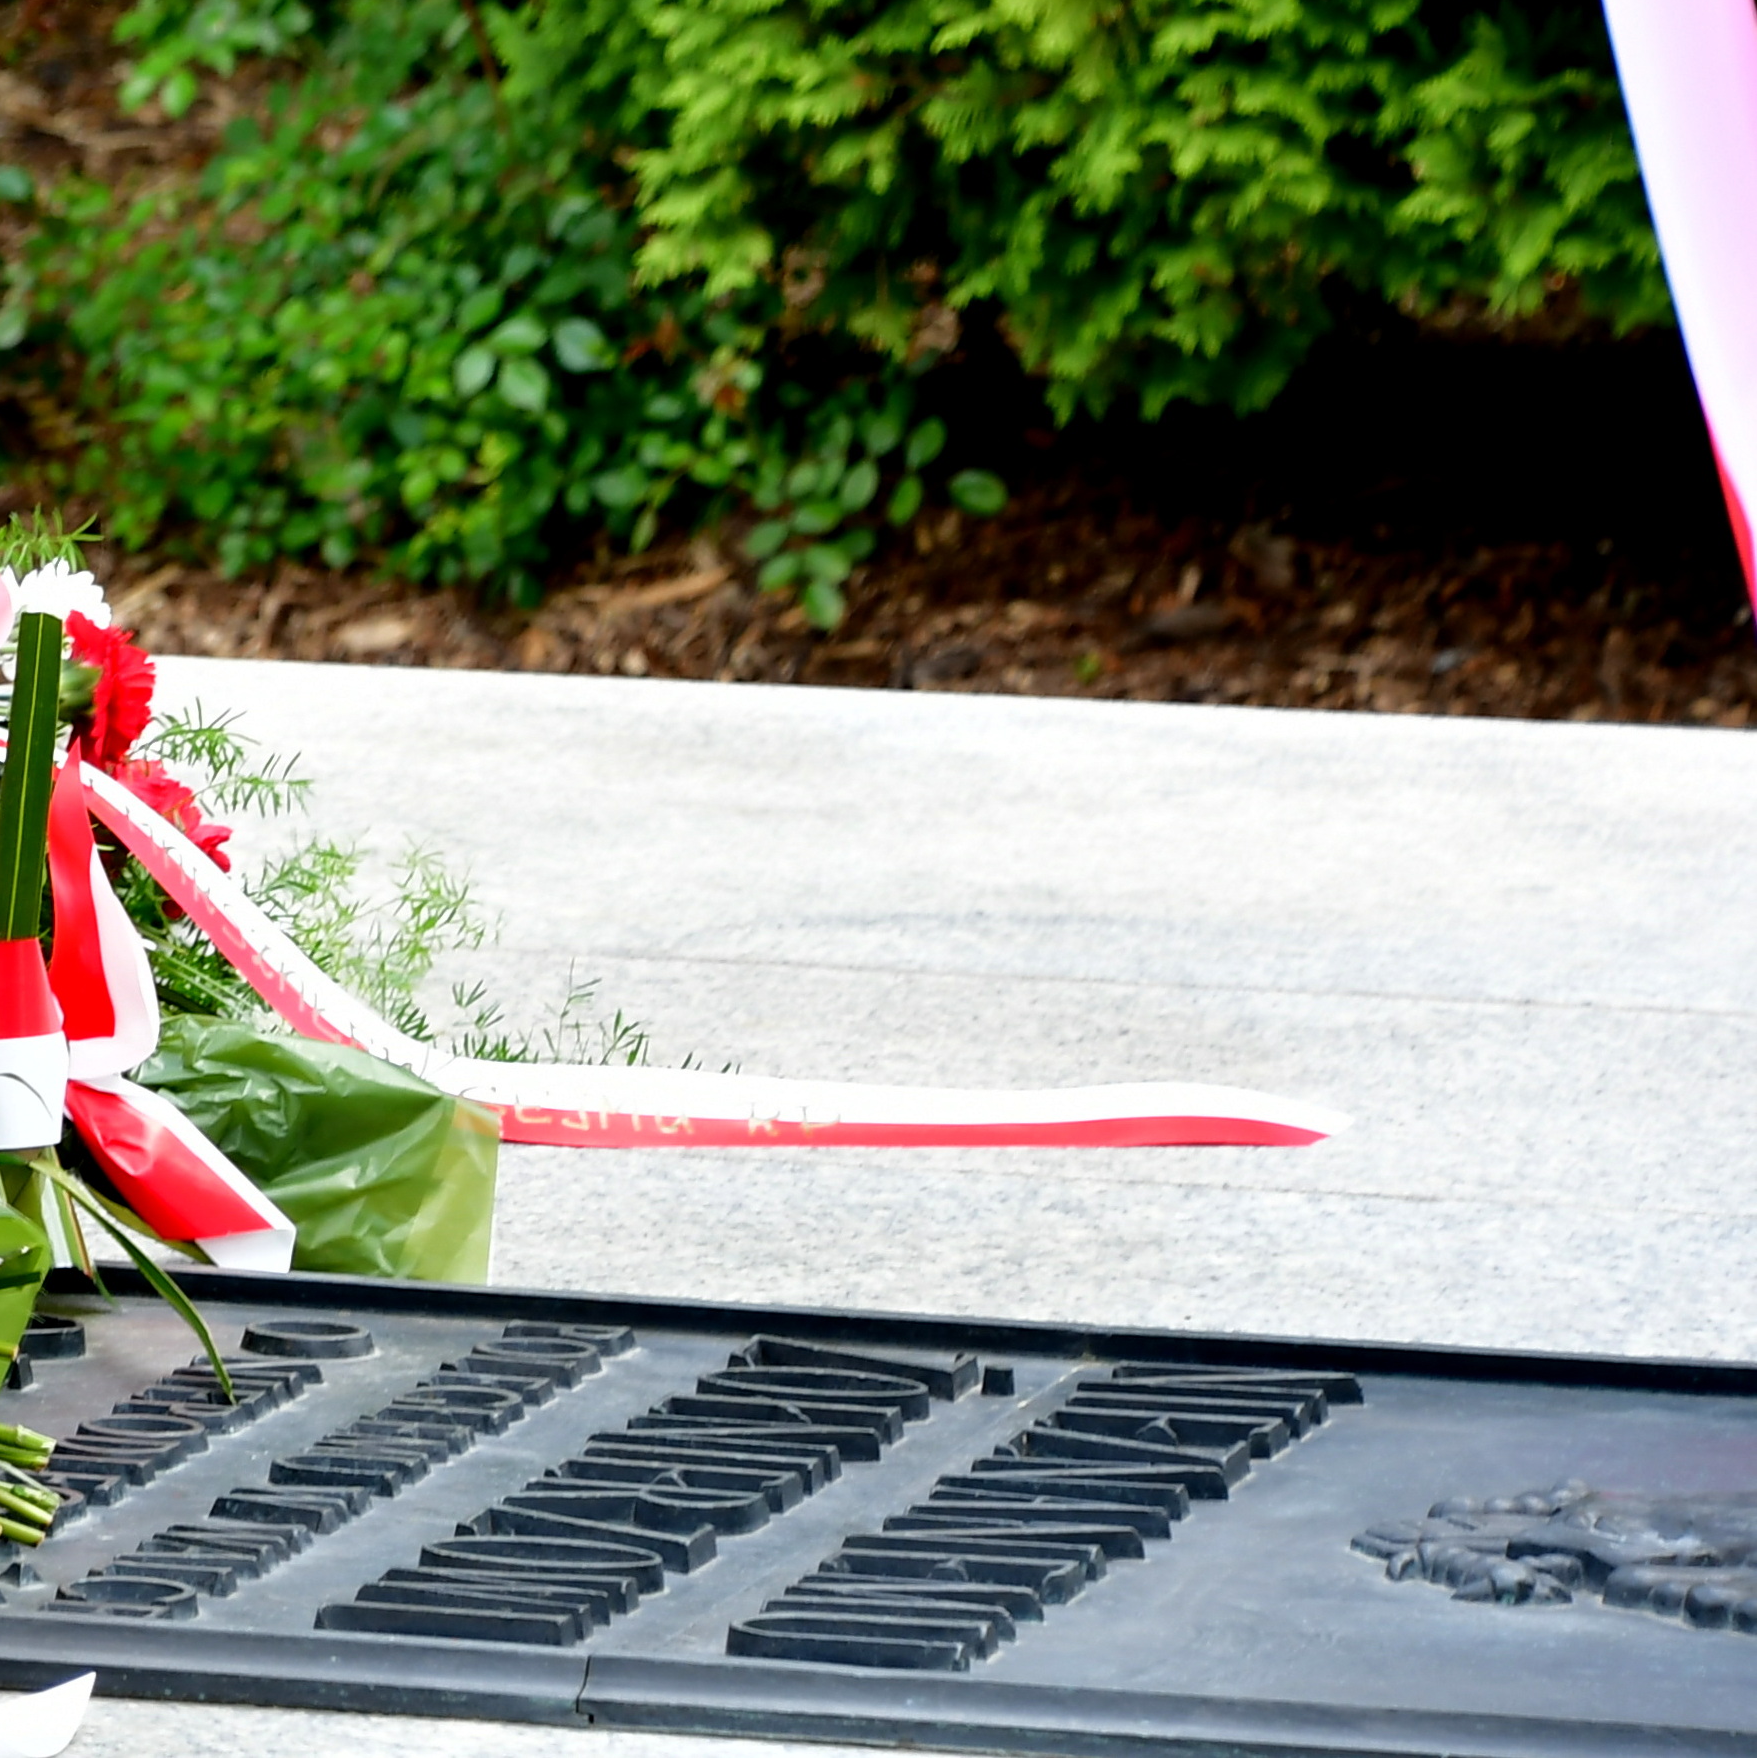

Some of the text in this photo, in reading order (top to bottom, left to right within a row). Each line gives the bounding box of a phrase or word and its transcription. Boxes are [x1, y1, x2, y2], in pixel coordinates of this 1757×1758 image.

[240, 1320, 375, 1359] O
[313, 1333, 1016, 1646] ŻOŁNIERZOWI
[726, 1359, 1364, 1670] NIEZNANEMU
